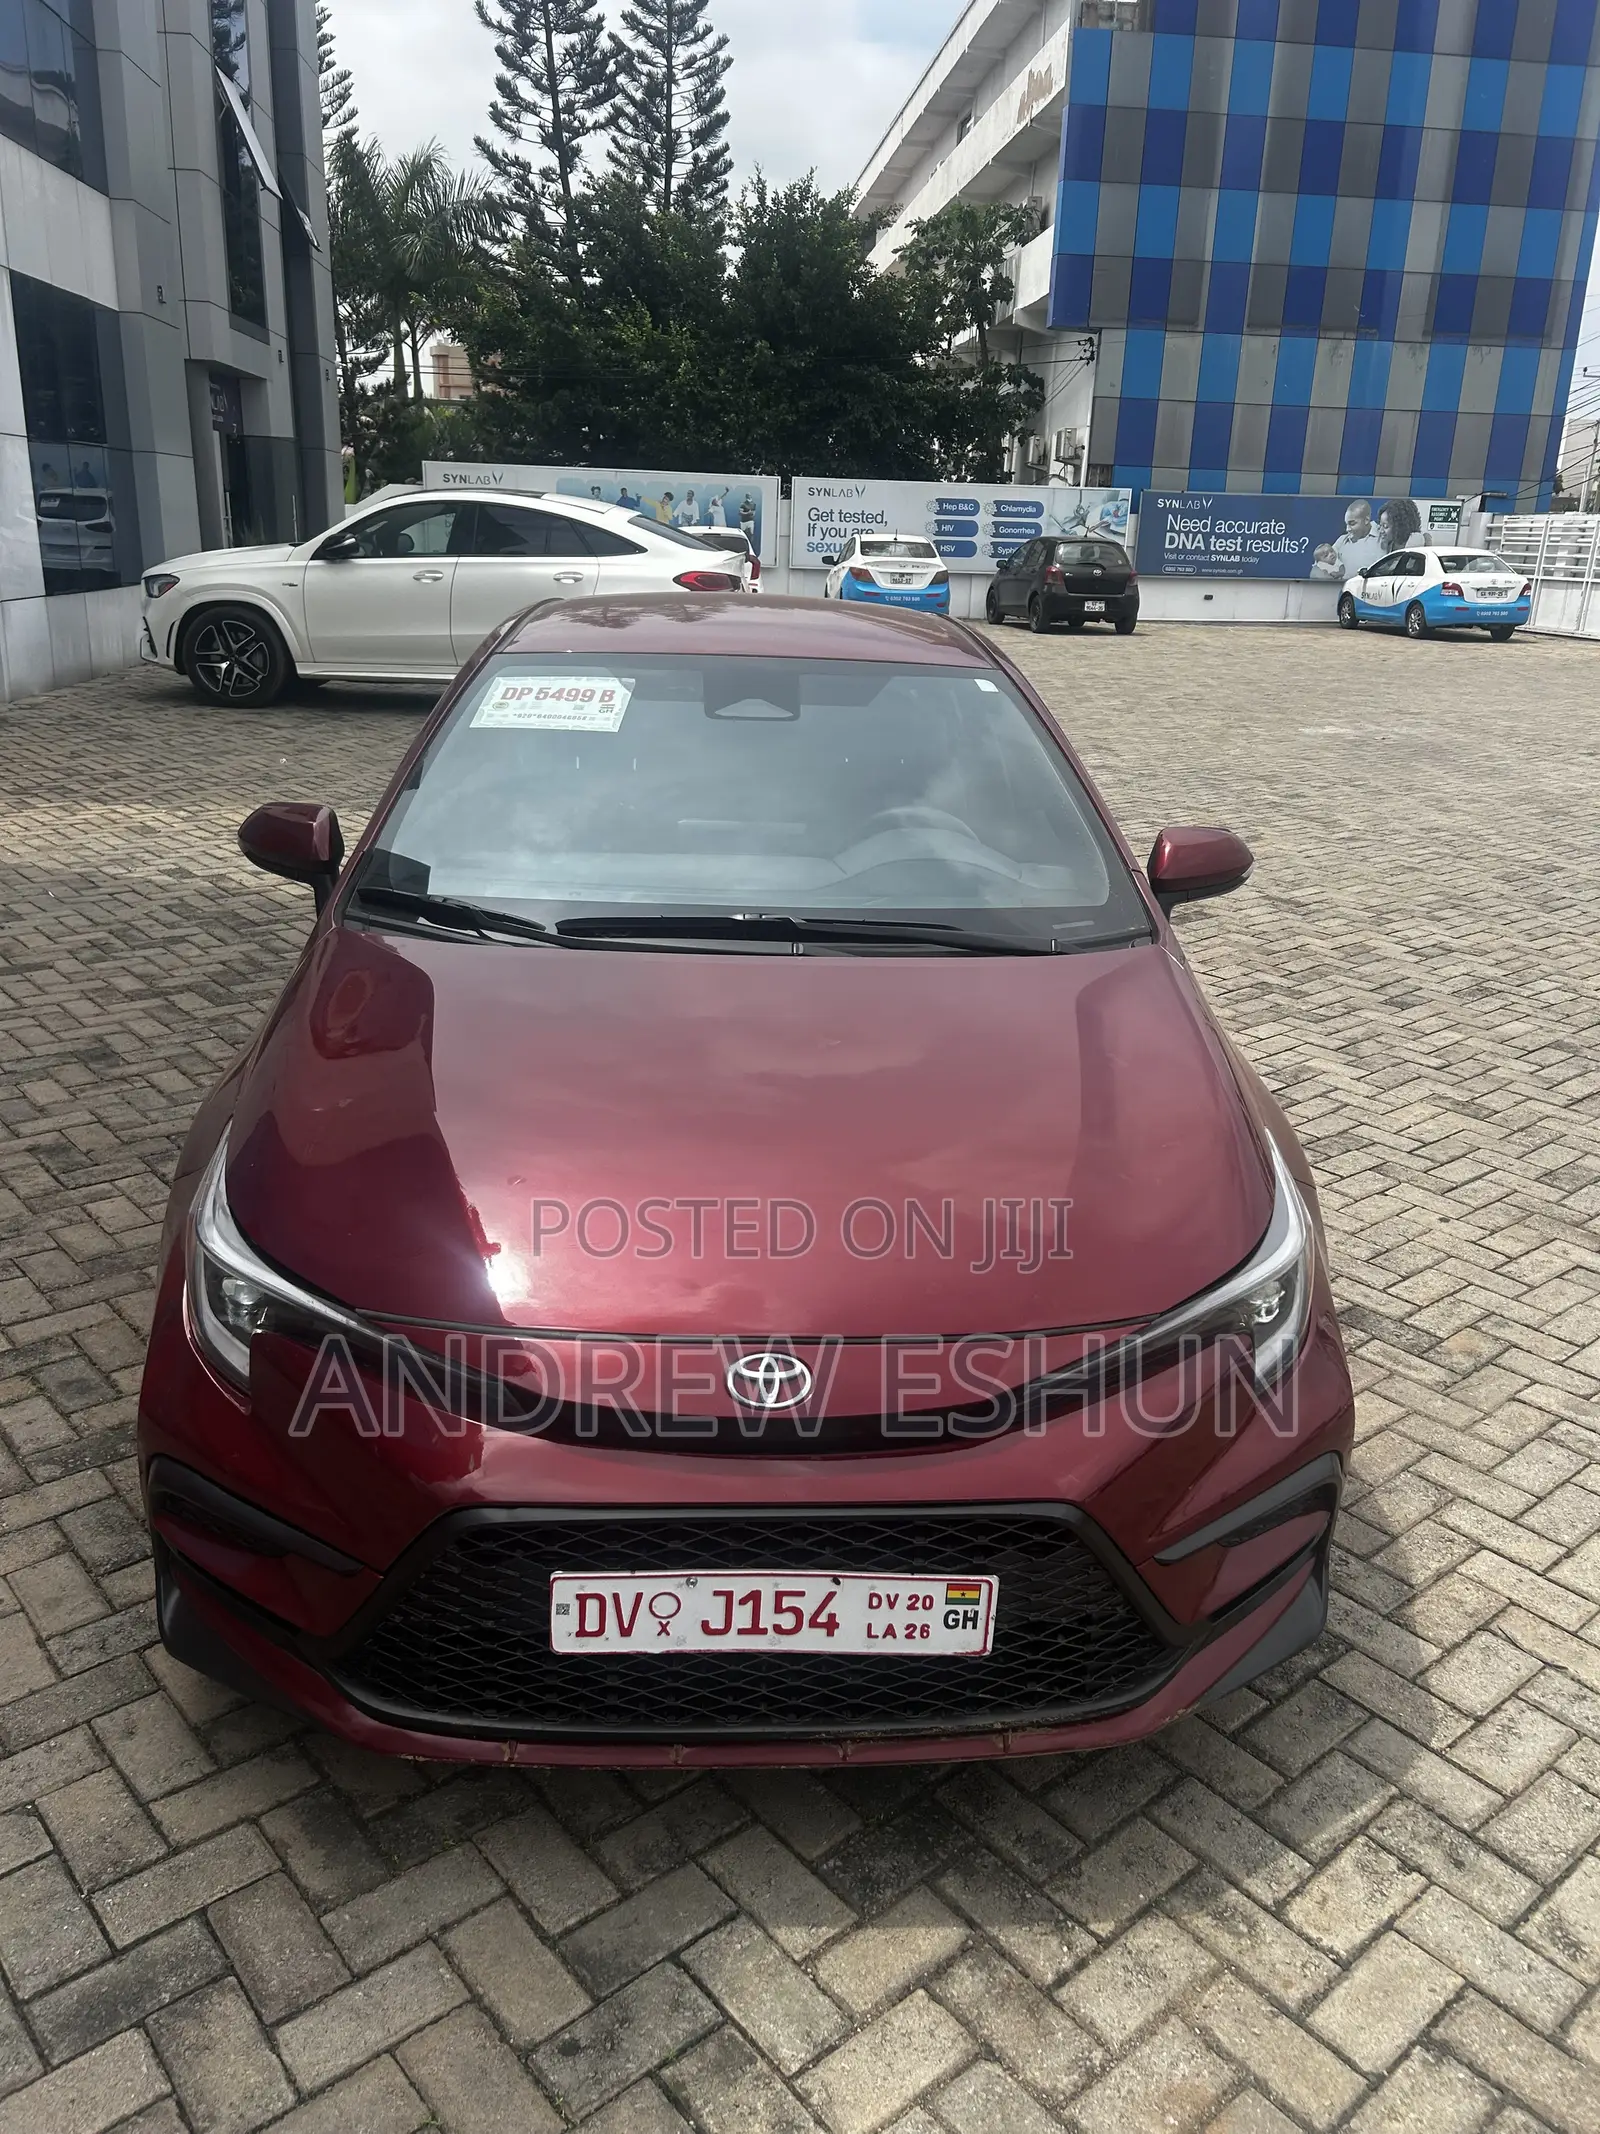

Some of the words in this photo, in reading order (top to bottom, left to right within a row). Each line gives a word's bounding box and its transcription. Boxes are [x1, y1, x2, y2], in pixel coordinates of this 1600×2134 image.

[442, 473, 491, 485] SYNLAB
[808, 486, 854, 498] SYNLAB
[943, 503, 957, 511] Hep
[958, 503, 975, 511] B&C
[1000, 504, 1037, 513] Chlamydia
[1157, 498, 1200, 510] SYNLAB
[808, 507, 835, 522] Get
[838, 509, 888, 527] tested,
[941, 524, 955, 532] HIV
[999, 526, 1036, 535] Gonorrhea
[1166, 514, 1212, 533] Need
[1215, 519, 1286, 535] accurate
[807, 523, 817, 537] If
[820, 526, 847, 541] you
[807, 541, 843, 553] sexu
[1164, 532, 1206, 551] DNA
[1209, 535, 1244, 552] test
[1246, 537, 1310, 554] results?
[1164, 552, 1177, 560] Visit
[1210, 554, 1240, 562] SYNLAB
[1241, 556, 1260, 564] today
[501, 687, 533, 700] DP
[535, 687, 596, 702] 5499
[599, 689, 616, 703] B
[868, 1592, 900, 1610] DV
[906, 1593, 935, 1611] 20
[575, 1591, 644, 1638] DV
[701, 1589, 840, 1637] J154
[942, 1608, 980, 1630] GH
[866, 1622, 897, 1640] LA
[904, 1623, 931, 1640] 26
